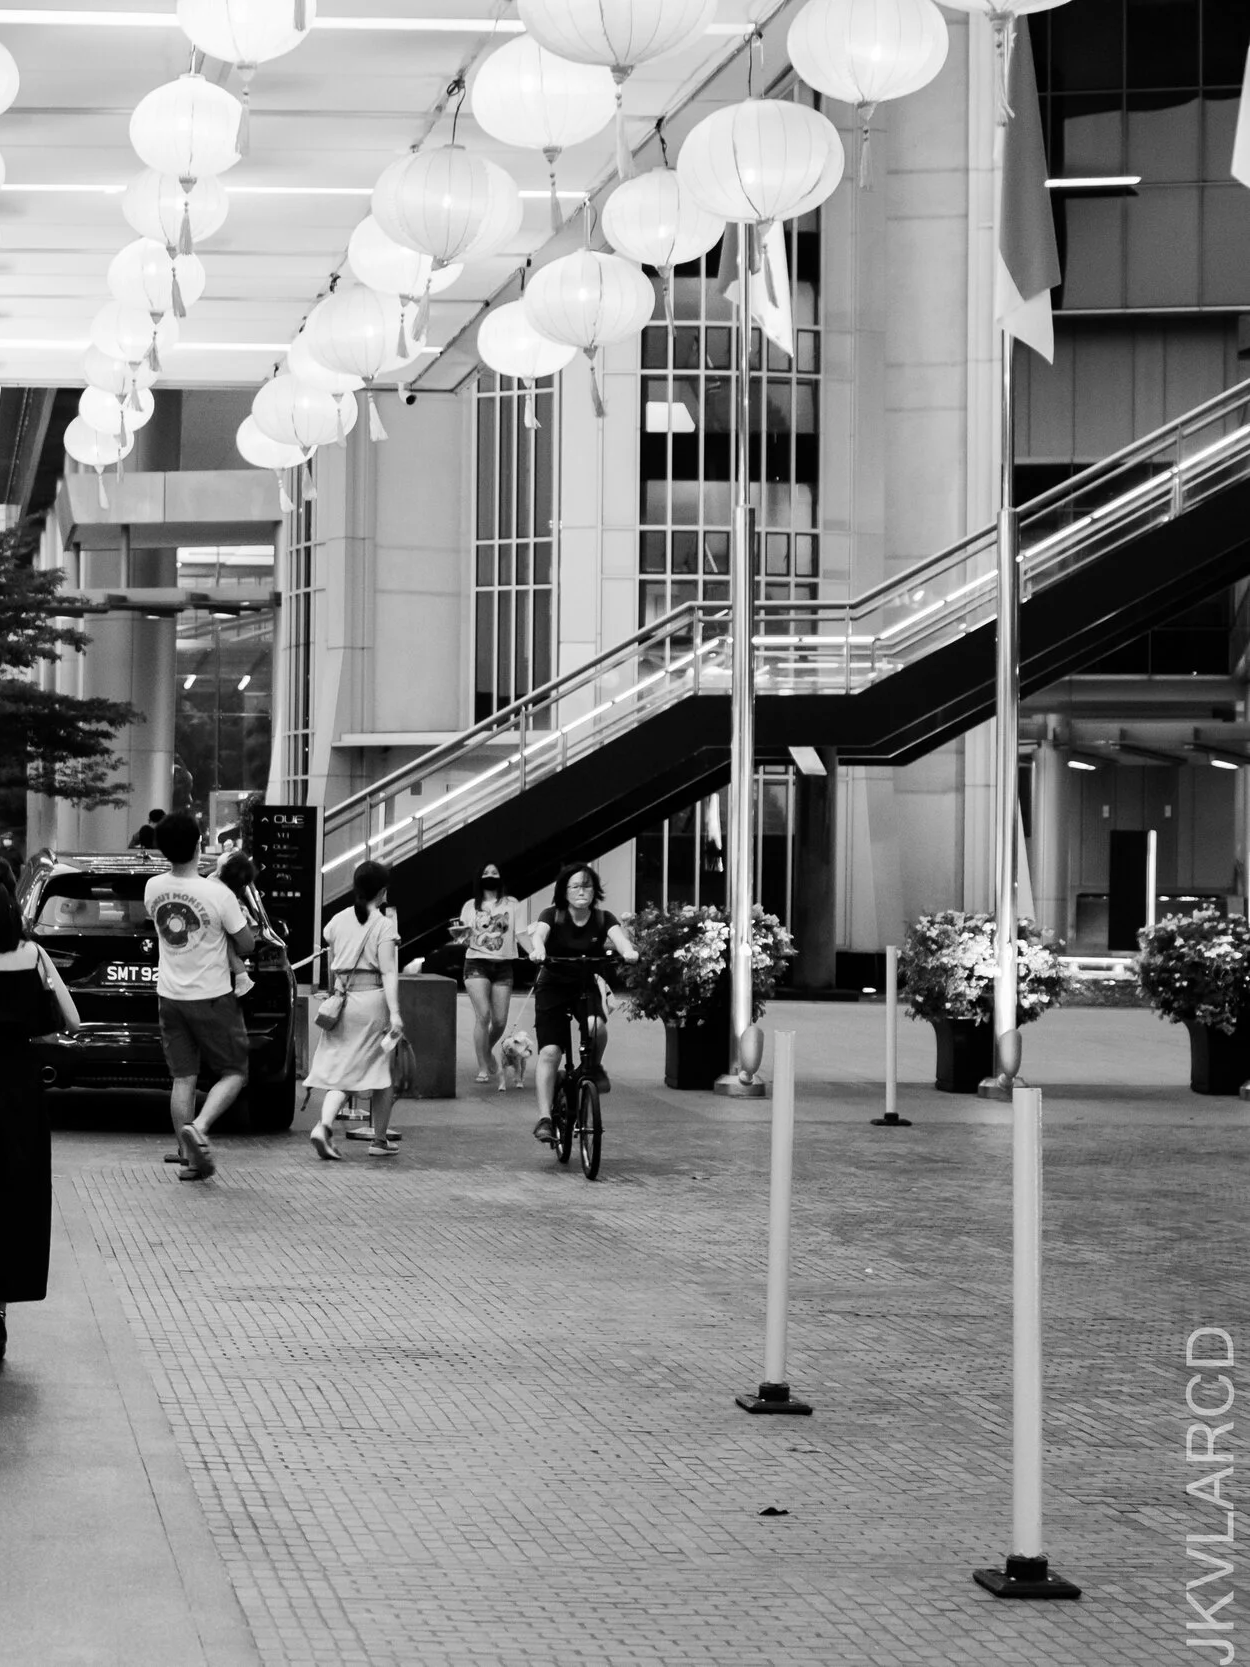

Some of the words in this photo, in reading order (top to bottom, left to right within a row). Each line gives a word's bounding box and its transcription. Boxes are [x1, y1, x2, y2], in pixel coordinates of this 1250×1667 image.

[273, 814, 305, 825] OUE
[172, 892, 211, 926] MONSTER
[106, 965, 139, 981] SMT
